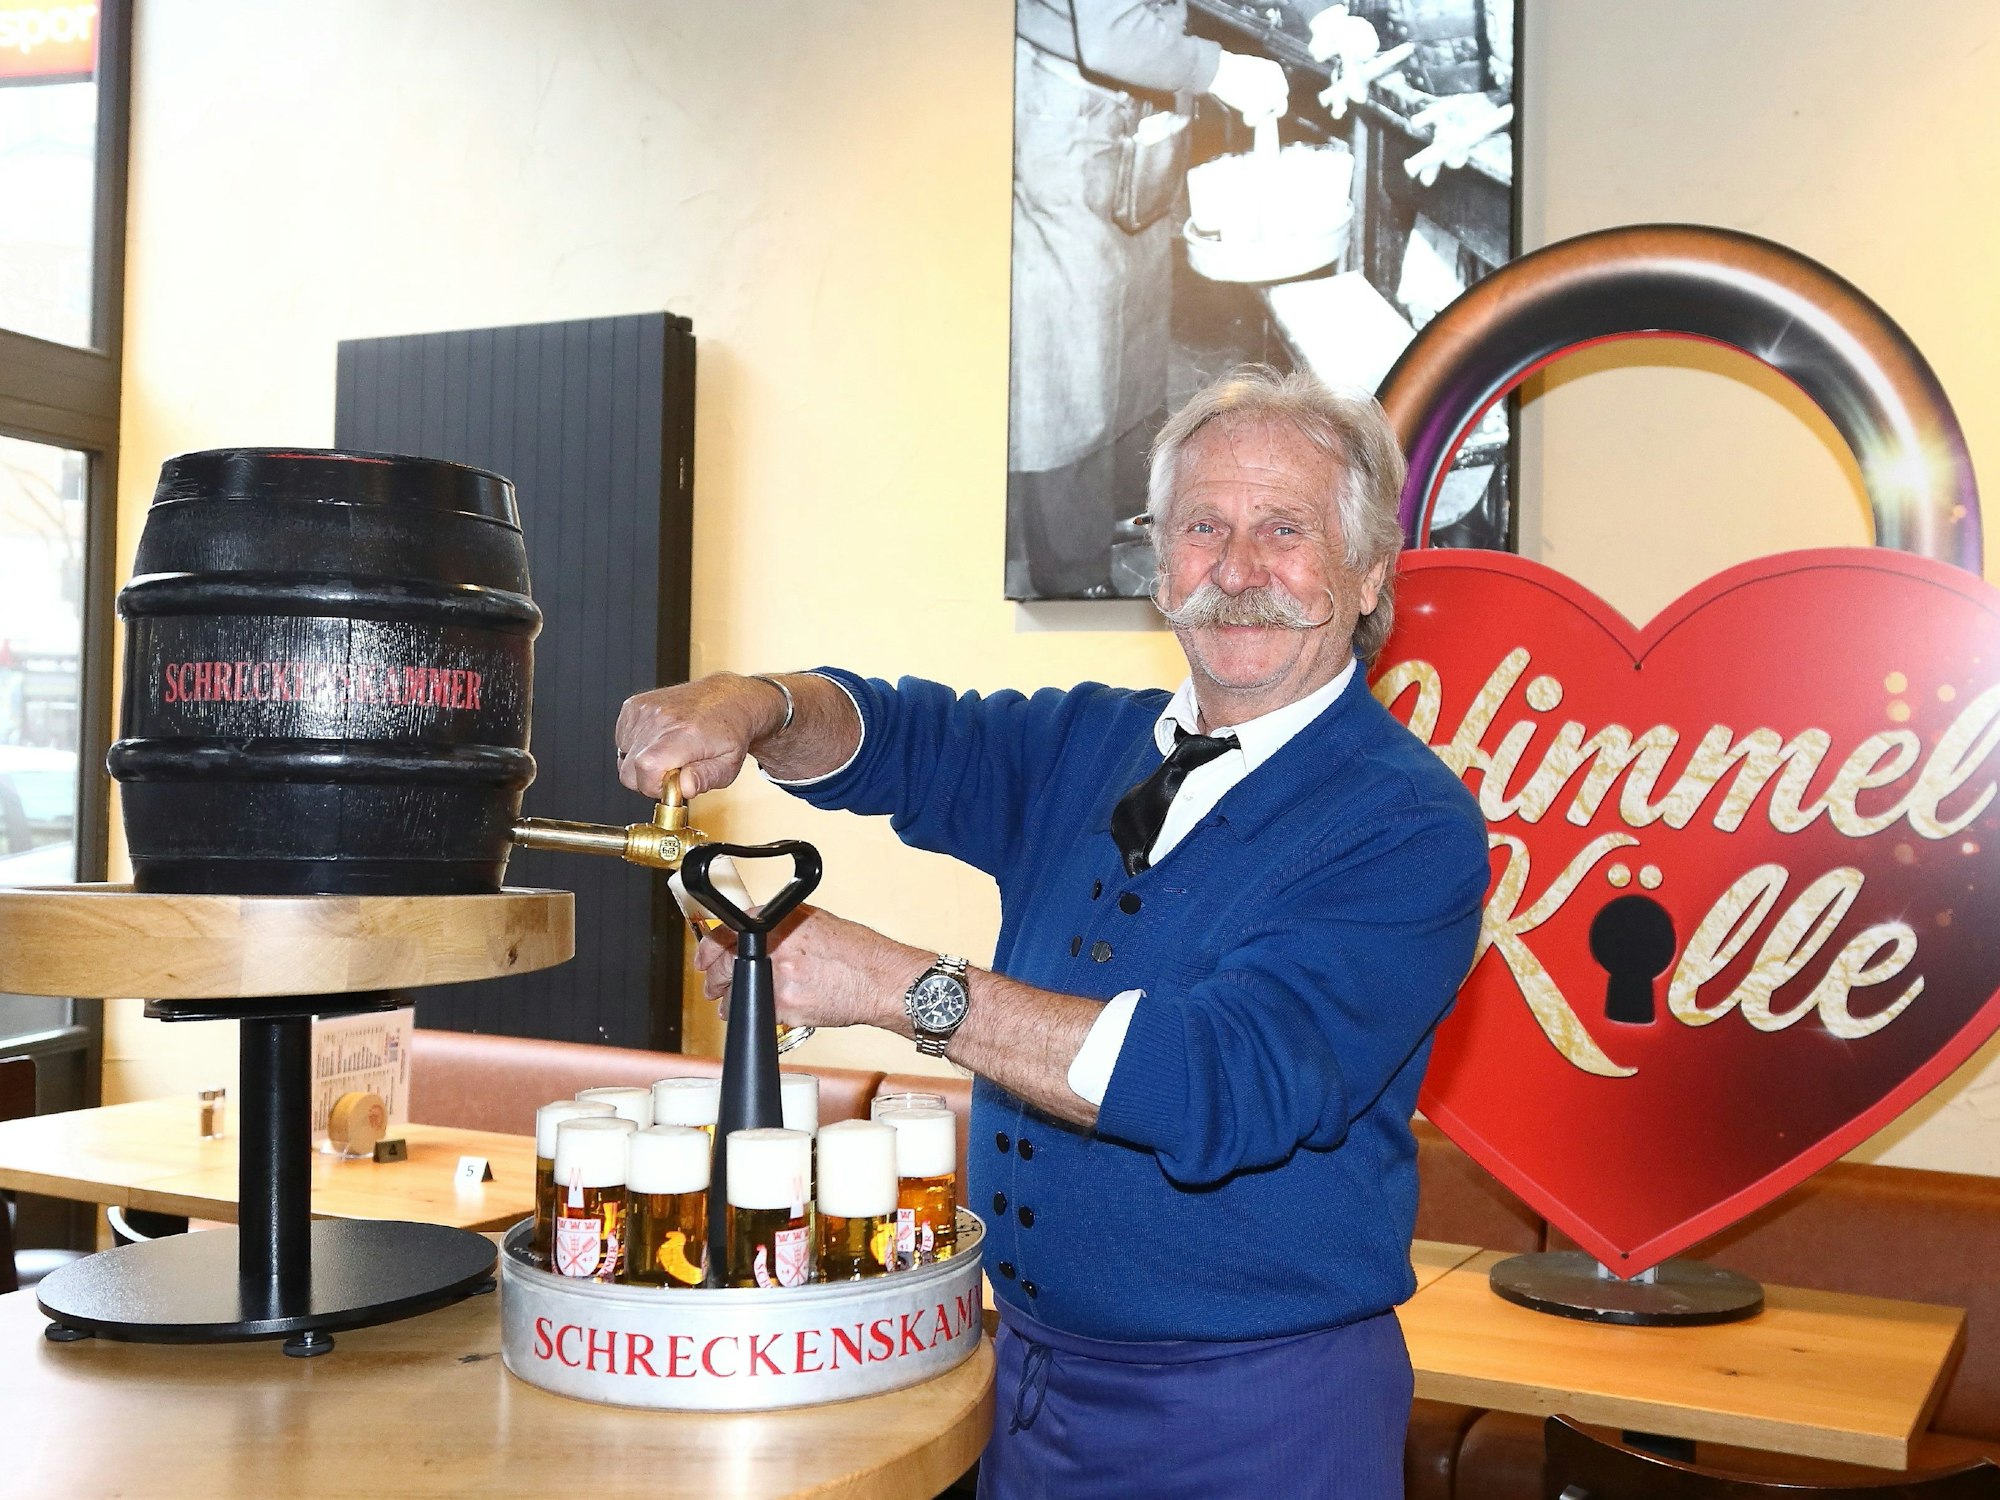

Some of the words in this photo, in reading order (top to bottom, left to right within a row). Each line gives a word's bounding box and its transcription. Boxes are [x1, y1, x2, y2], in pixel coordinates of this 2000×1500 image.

[165, 661, 482, 710] SCHRECKESKAMMER
[1371, 647, 2000, 840] Himmel
[465, 1165, 475, 1177] 5
